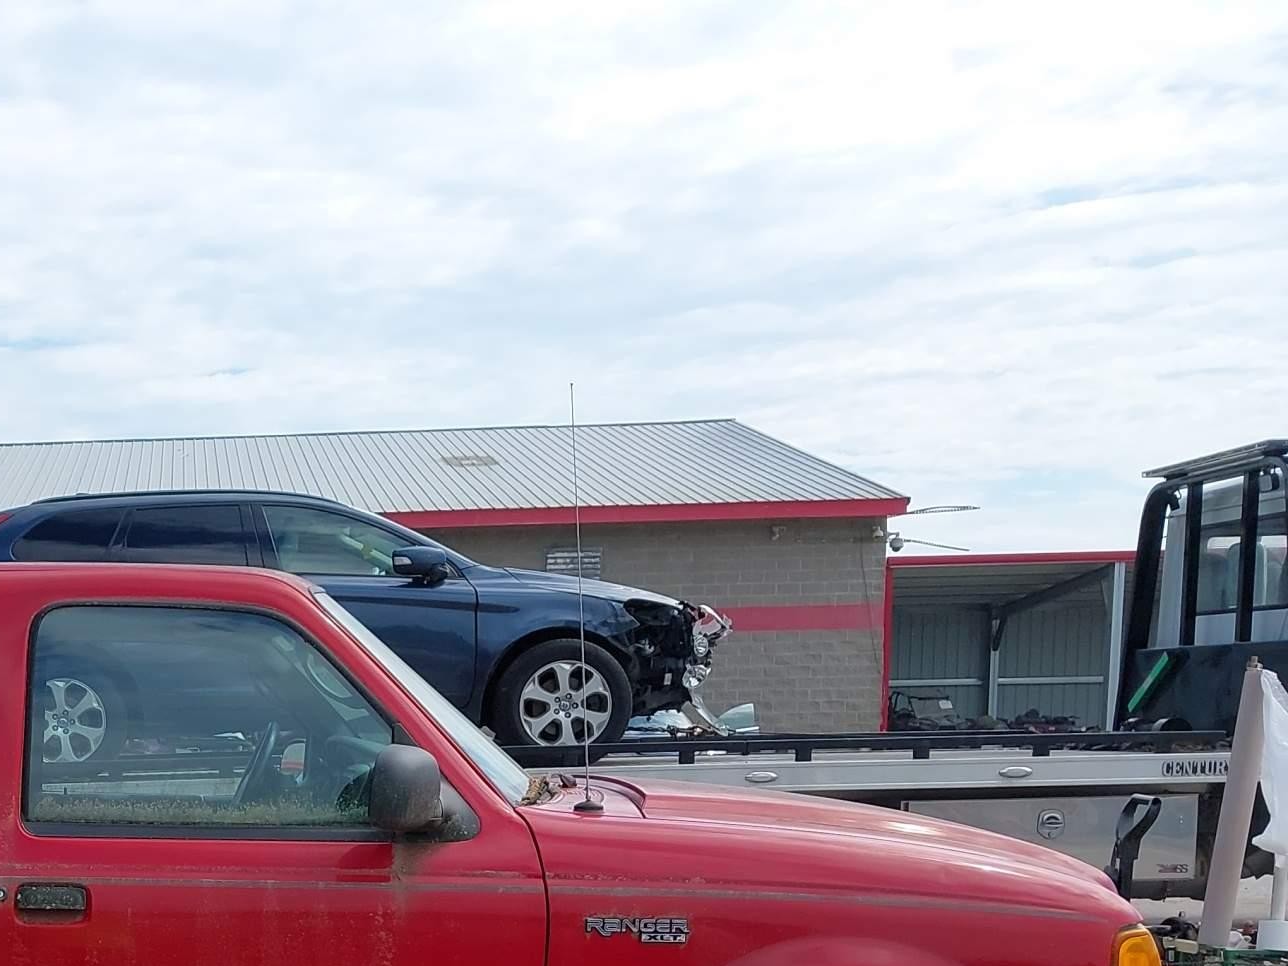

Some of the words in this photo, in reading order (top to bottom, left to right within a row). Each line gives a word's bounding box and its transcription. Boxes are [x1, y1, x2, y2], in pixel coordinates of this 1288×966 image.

[1161, 759, 1229, 777] CENTUR
[584, 917, 691, 936] RANGER
[644, 933, 684, 942] XLT
